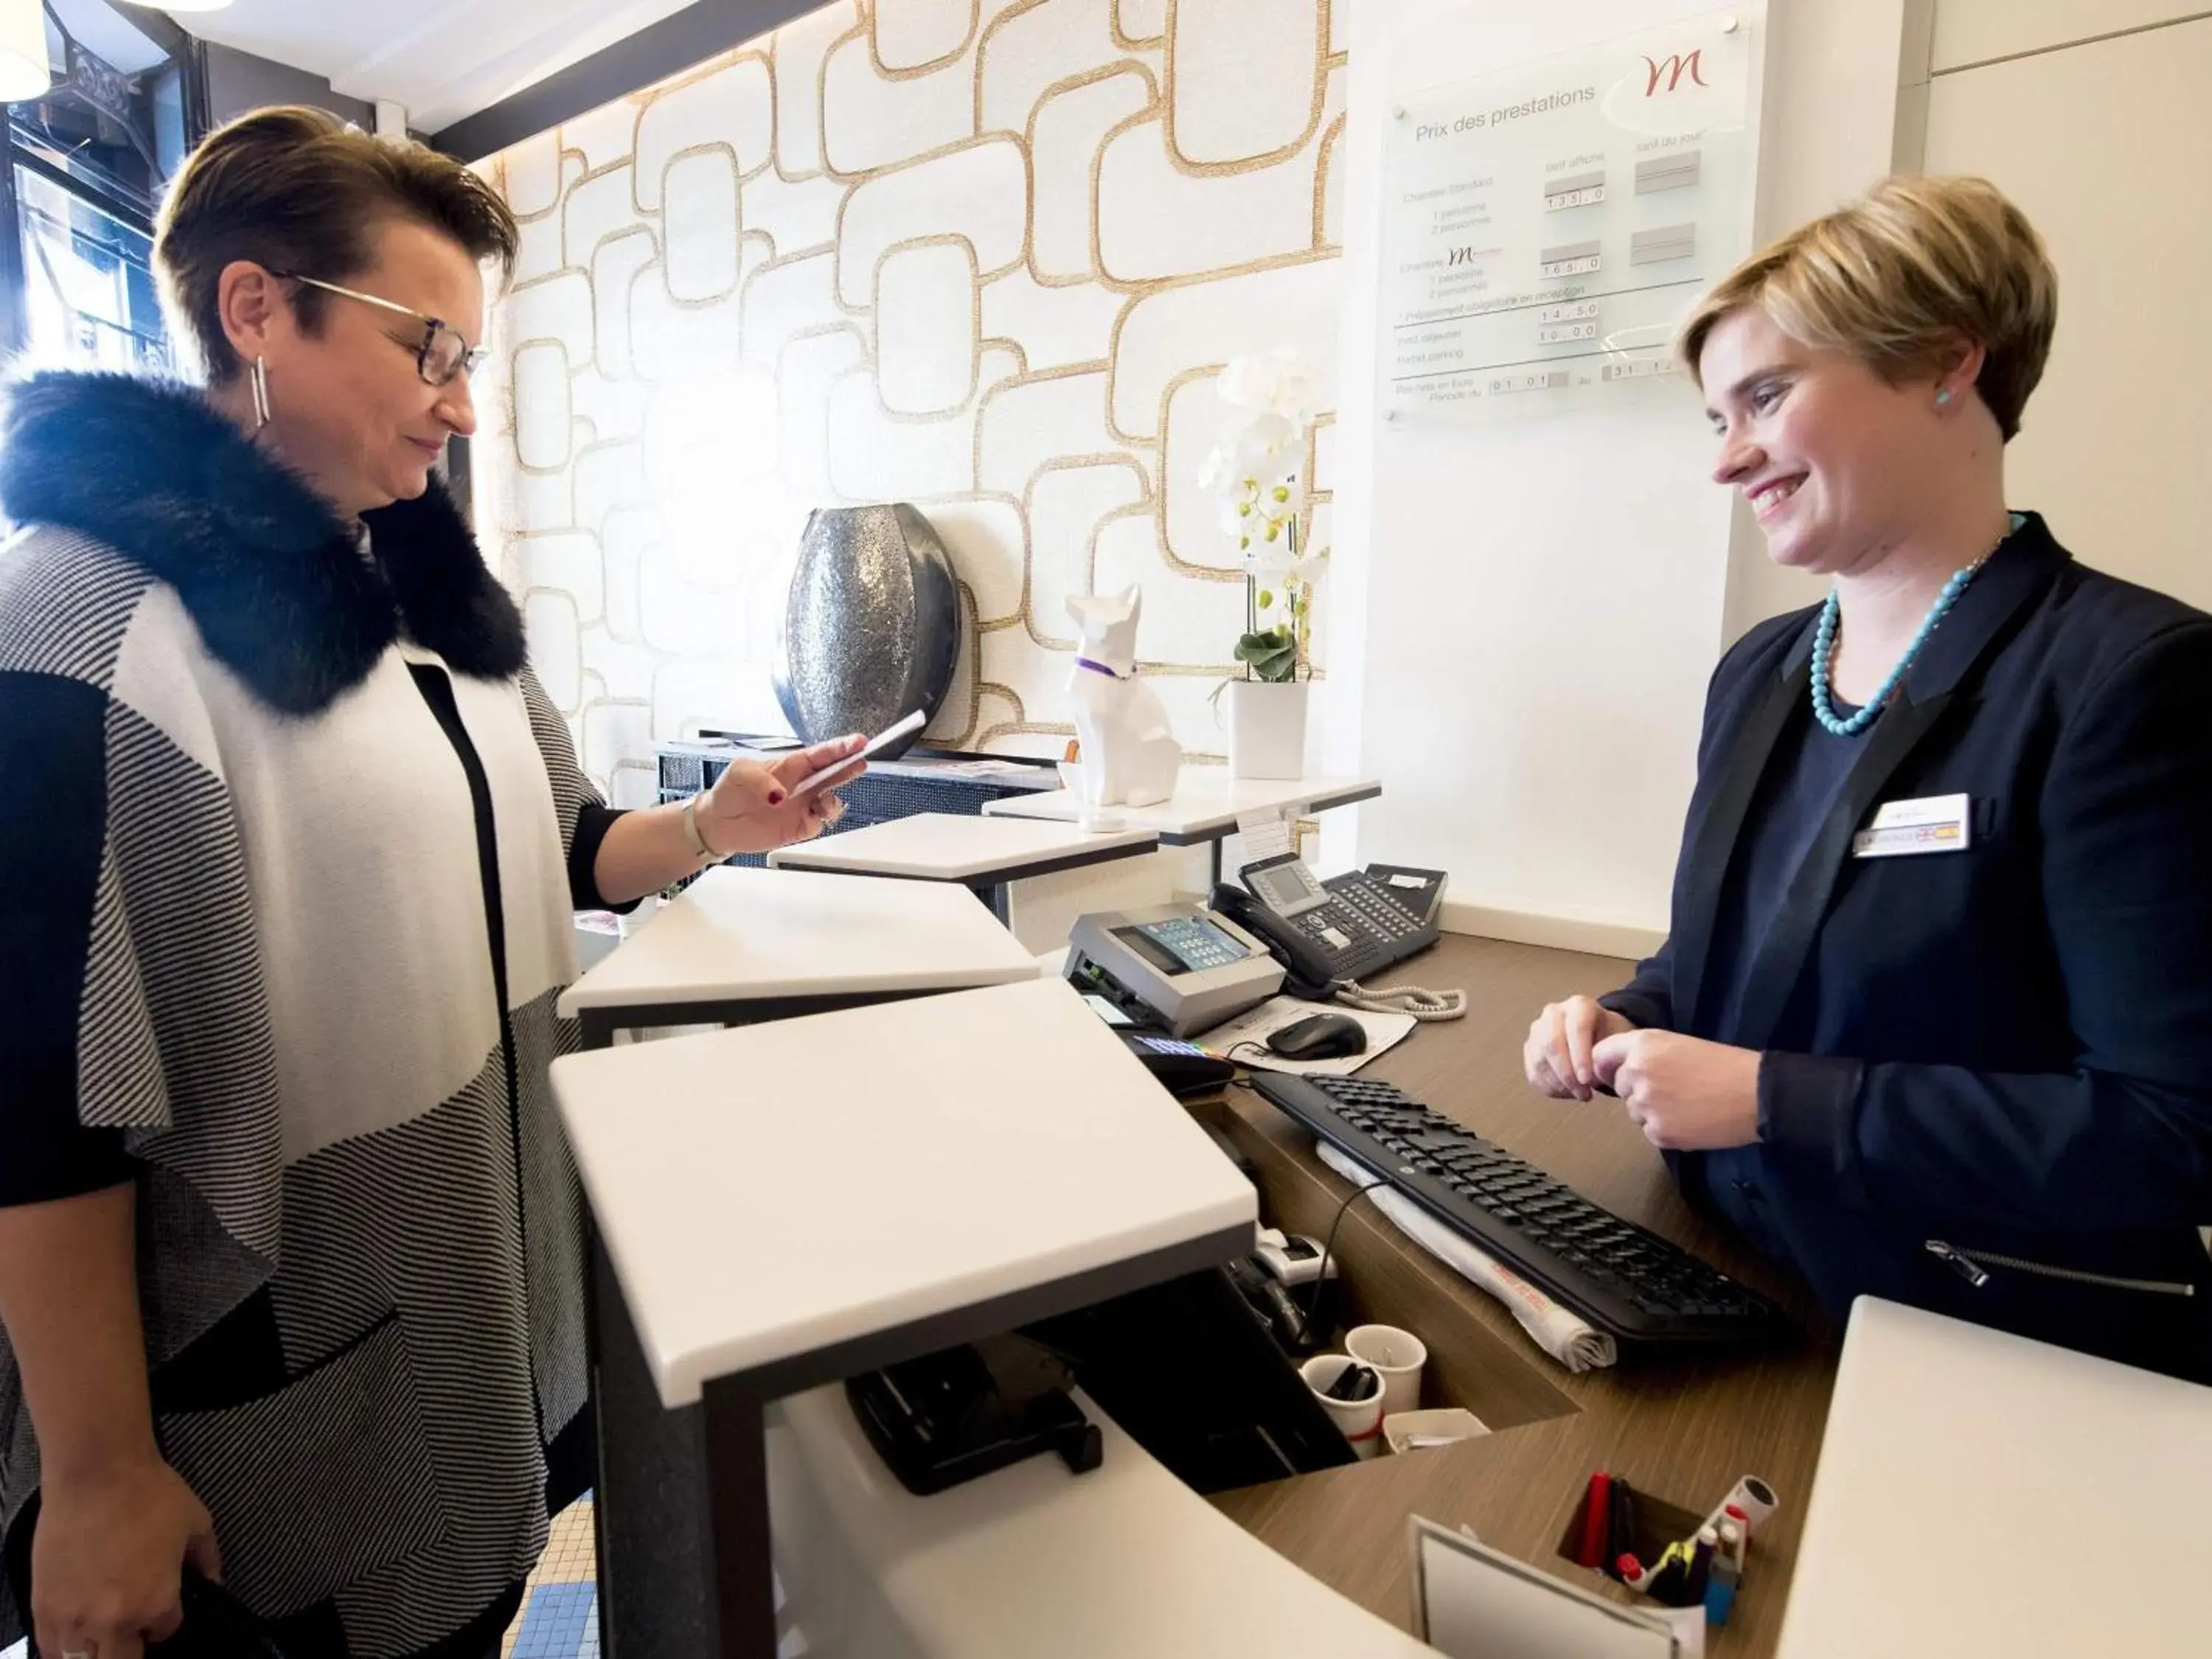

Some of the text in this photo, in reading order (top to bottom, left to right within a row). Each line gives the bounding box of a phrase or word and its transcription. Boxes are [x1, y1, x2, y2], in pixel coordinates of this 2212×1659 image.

[1416, 86, 1596, 142] Prix des prestations
